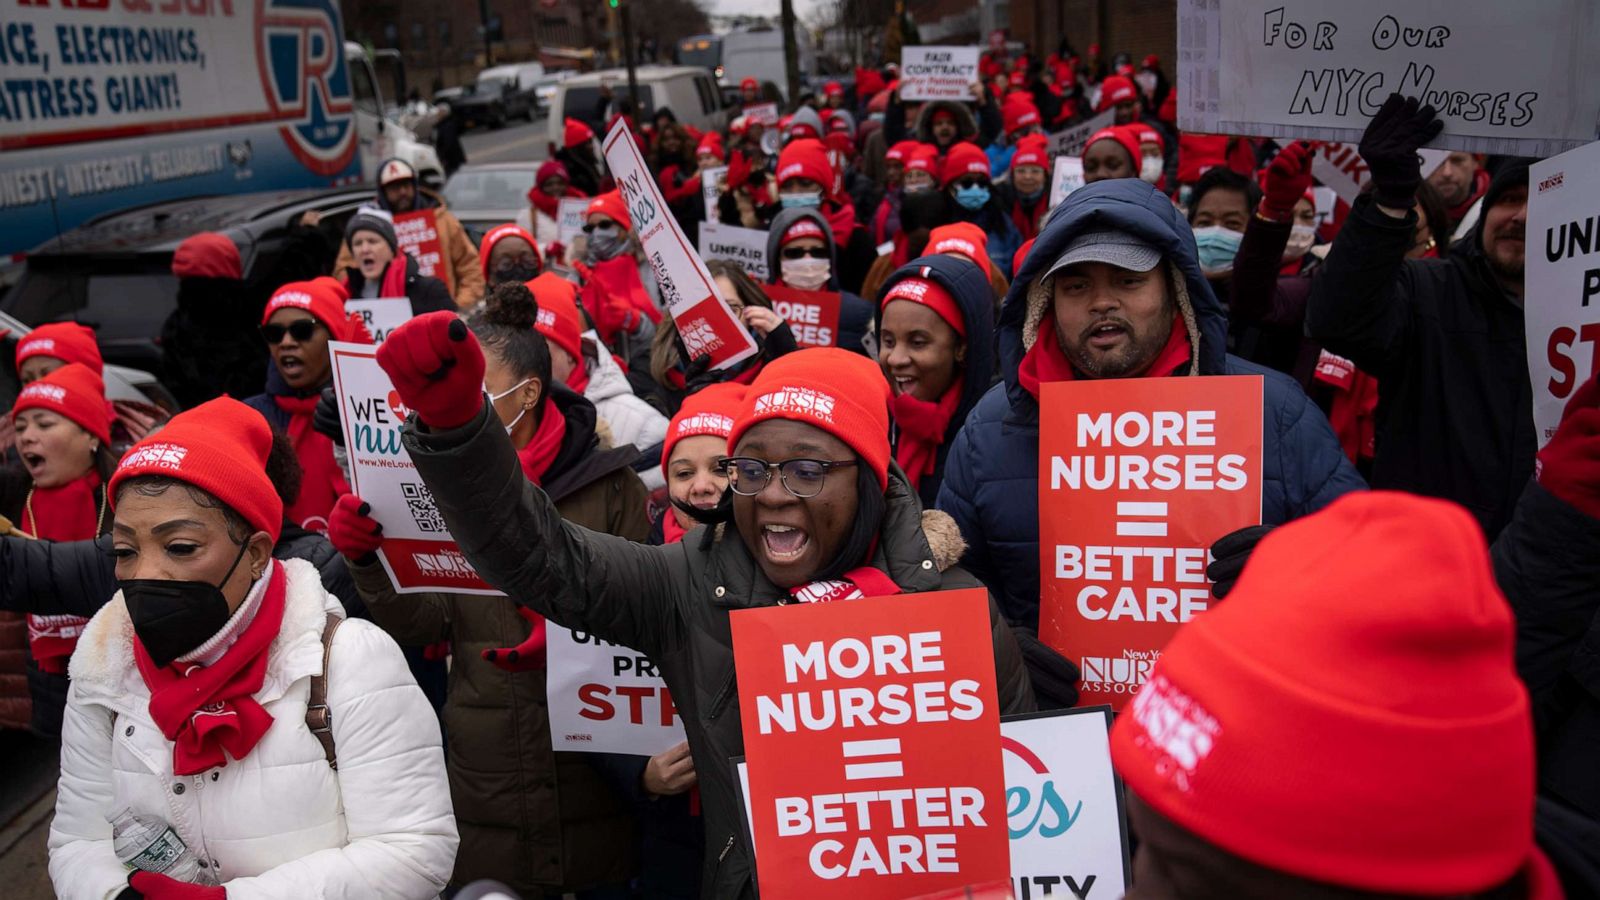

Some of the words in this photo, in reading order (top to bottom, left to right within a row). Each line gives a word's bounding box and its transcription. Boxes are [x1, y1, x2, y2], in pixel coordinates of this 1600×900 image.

[55, 24, 206, 68] ELECTRONICS,
[905, 64, 974, 76] CONTRACT
[104, 73, 182, 114] GIANT!
[709, 243, 763, 262] UNFAIR
[350, 395, 390, 425] WE
[754, 391, 836, 416] NURSES
[1076, 410, 1216, 447] MORE
[1050, 454, 1248, 491] NURSES
[1076, 585, 1209, 623] CARE
[782, 630, 945, 683] MORE
[1122, 648, 1150, 660] New
[1081, 681, 1140, 695] ASSOC
[756, 679, 985, 735] NURSES
[774, 786, 988, 837] BETTER
[808, 833, 960, 880] CARE
